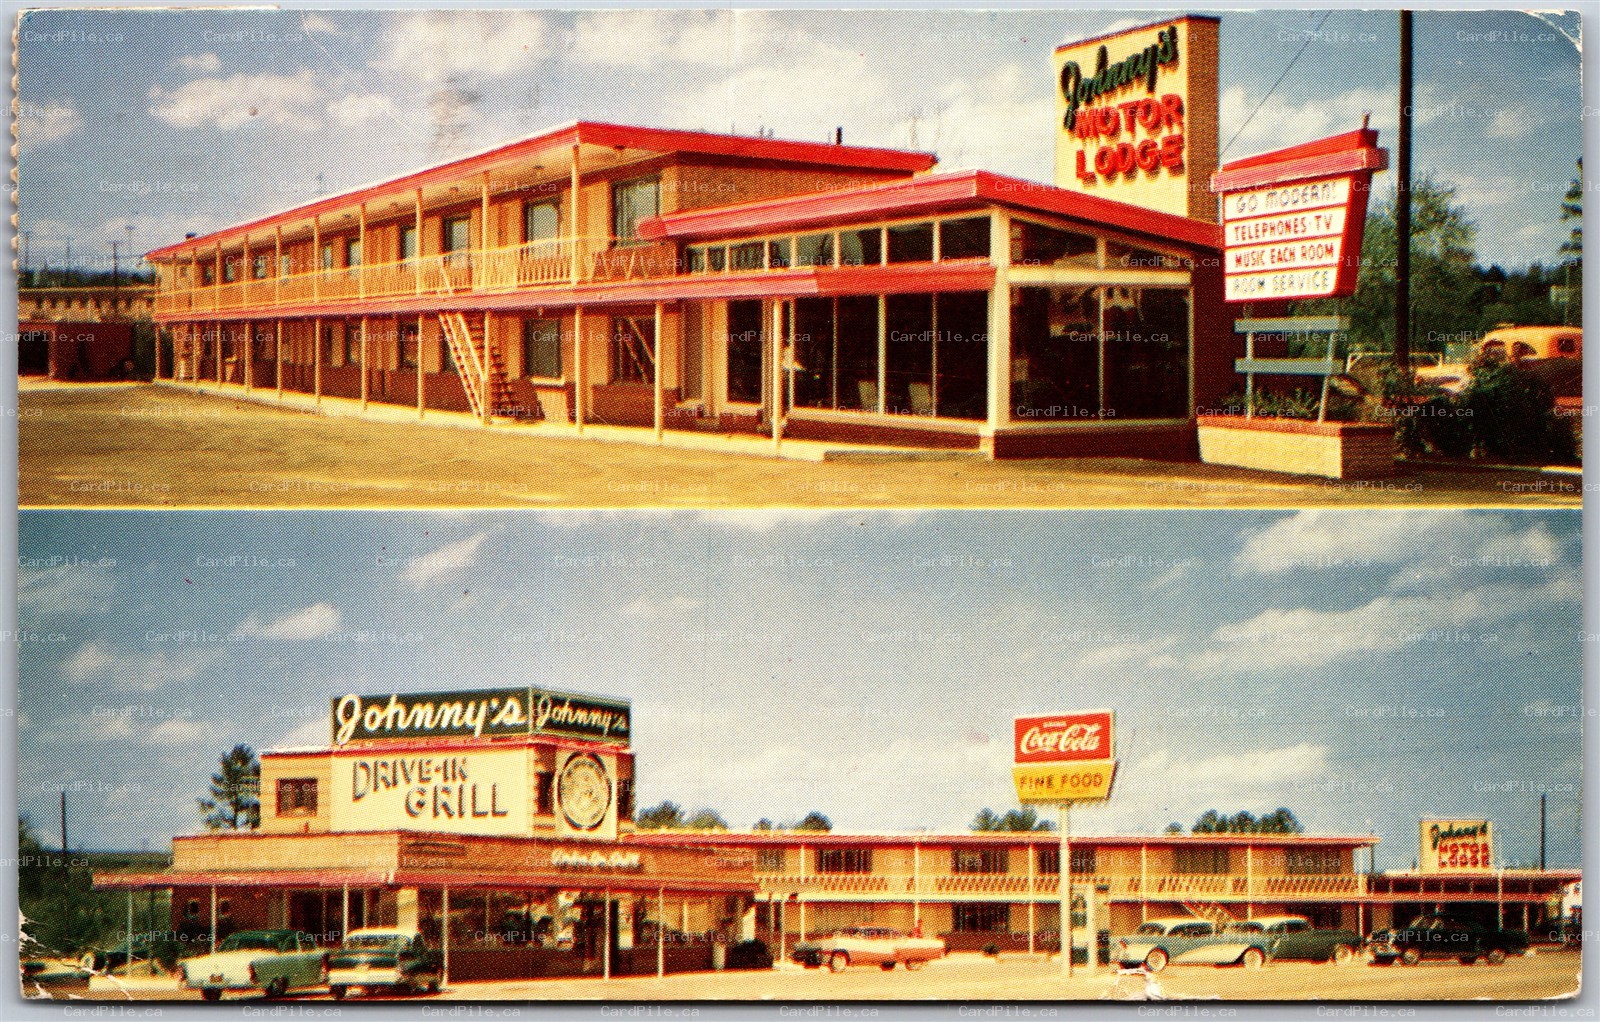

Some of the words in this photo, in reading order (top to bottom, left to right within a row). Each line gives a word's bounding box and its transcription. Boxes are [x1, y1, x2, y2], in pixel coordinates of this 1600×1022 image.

[1076, 94, 1184, 139] MOTOR
[1076, 134, 1184, 179] LODGE
[1234, 217, 1307, 241] TELEPHONES
[1314, 214, 1333, 232] TV
[1235, 250, 1265, 268] MUSIC
[1270, 246, 1296, 264] EACH
[1301, 243, 1334, 261] ROOM
[1272, 270, 1329, 293] SERVICE
[336, 694, 527, 745] Johnny's
[538, 694, 629, 736] Johnny's
[1020, 723, 1102, 755] Coca-Cola
[352, 757, 468, 801] DRIVE-IN
[1020, 774, 1054, 789] FINE
[1061, 772, 1103, 788] FOOD
[405, 783, 509, 818] GRILL
